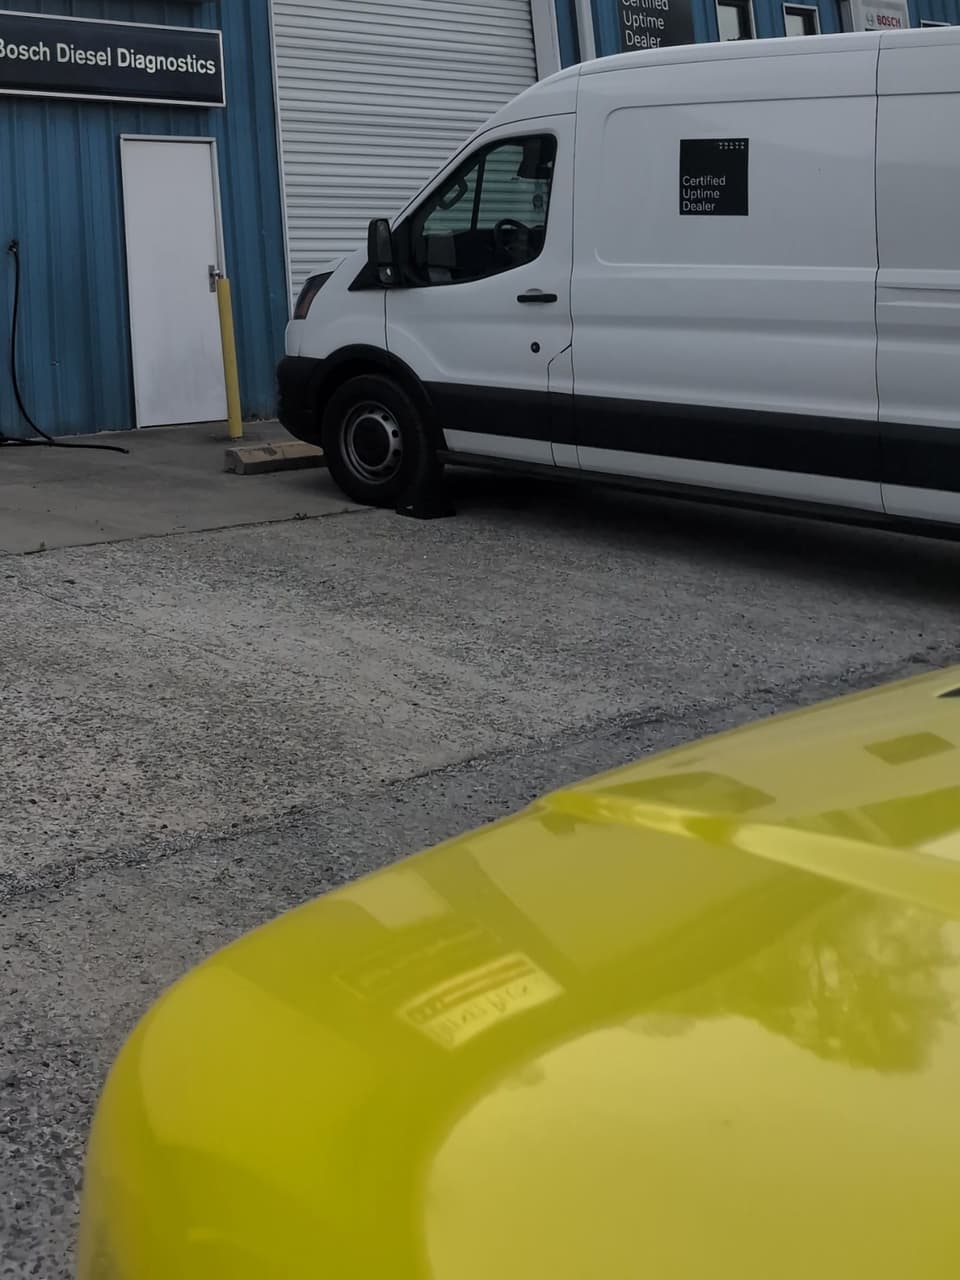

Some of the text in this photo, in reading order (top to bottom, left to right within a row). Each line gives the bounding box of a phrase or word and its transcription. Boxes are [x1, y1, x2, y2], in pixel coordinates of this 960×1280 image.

[623, 10, 665, 31] Uptime
[876, 14, 902, 28] BOSCH
[625, 30, 662, 48] Dealer
[56, 42, 112, 67] Diesel
[117, 48, 216, 75] Diagnostics
[682, 175, 726, 186] Certified
[682, 188, 720, 200] Uptime
[682, 200, 716, 211] Dealer
